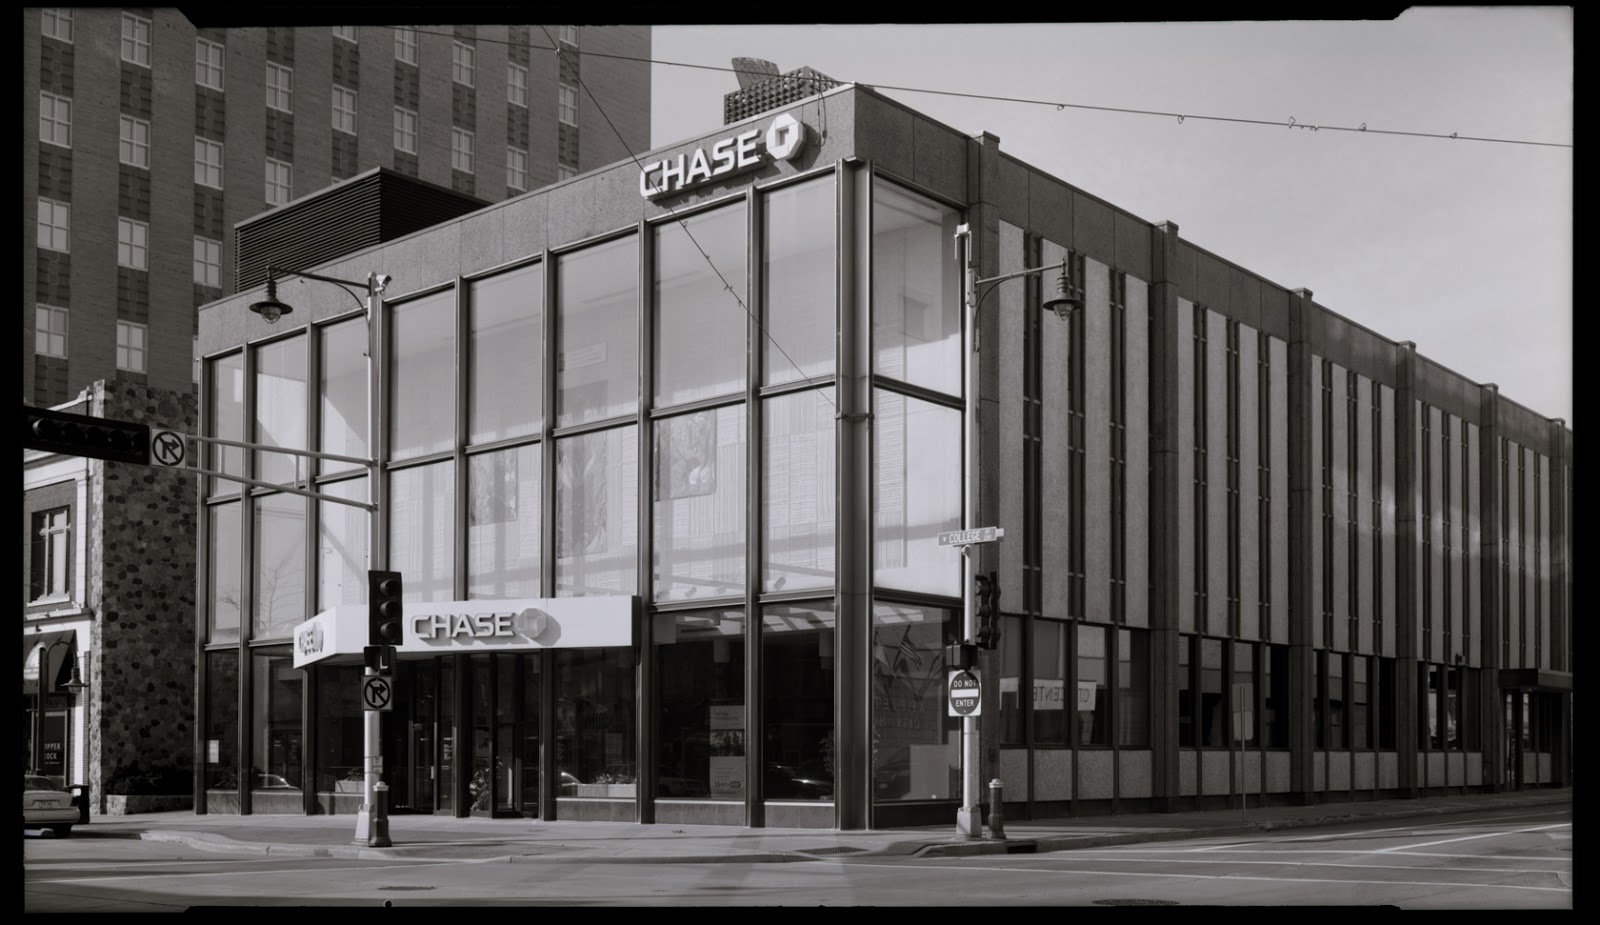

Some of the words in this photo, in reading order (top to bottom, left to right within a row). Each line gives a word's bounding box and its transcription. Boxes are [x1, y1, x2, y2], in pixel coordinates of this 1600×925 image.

[640, 129, 762, 198] CHASE
[949, 530, 981, 544] COLLEGE
[411, 612, 515, 639] CHASE
[964, 679, 977, 687] NOT
[955, 699, 974, 707] ENTER
[44, 742, 61, 750] OPPER
